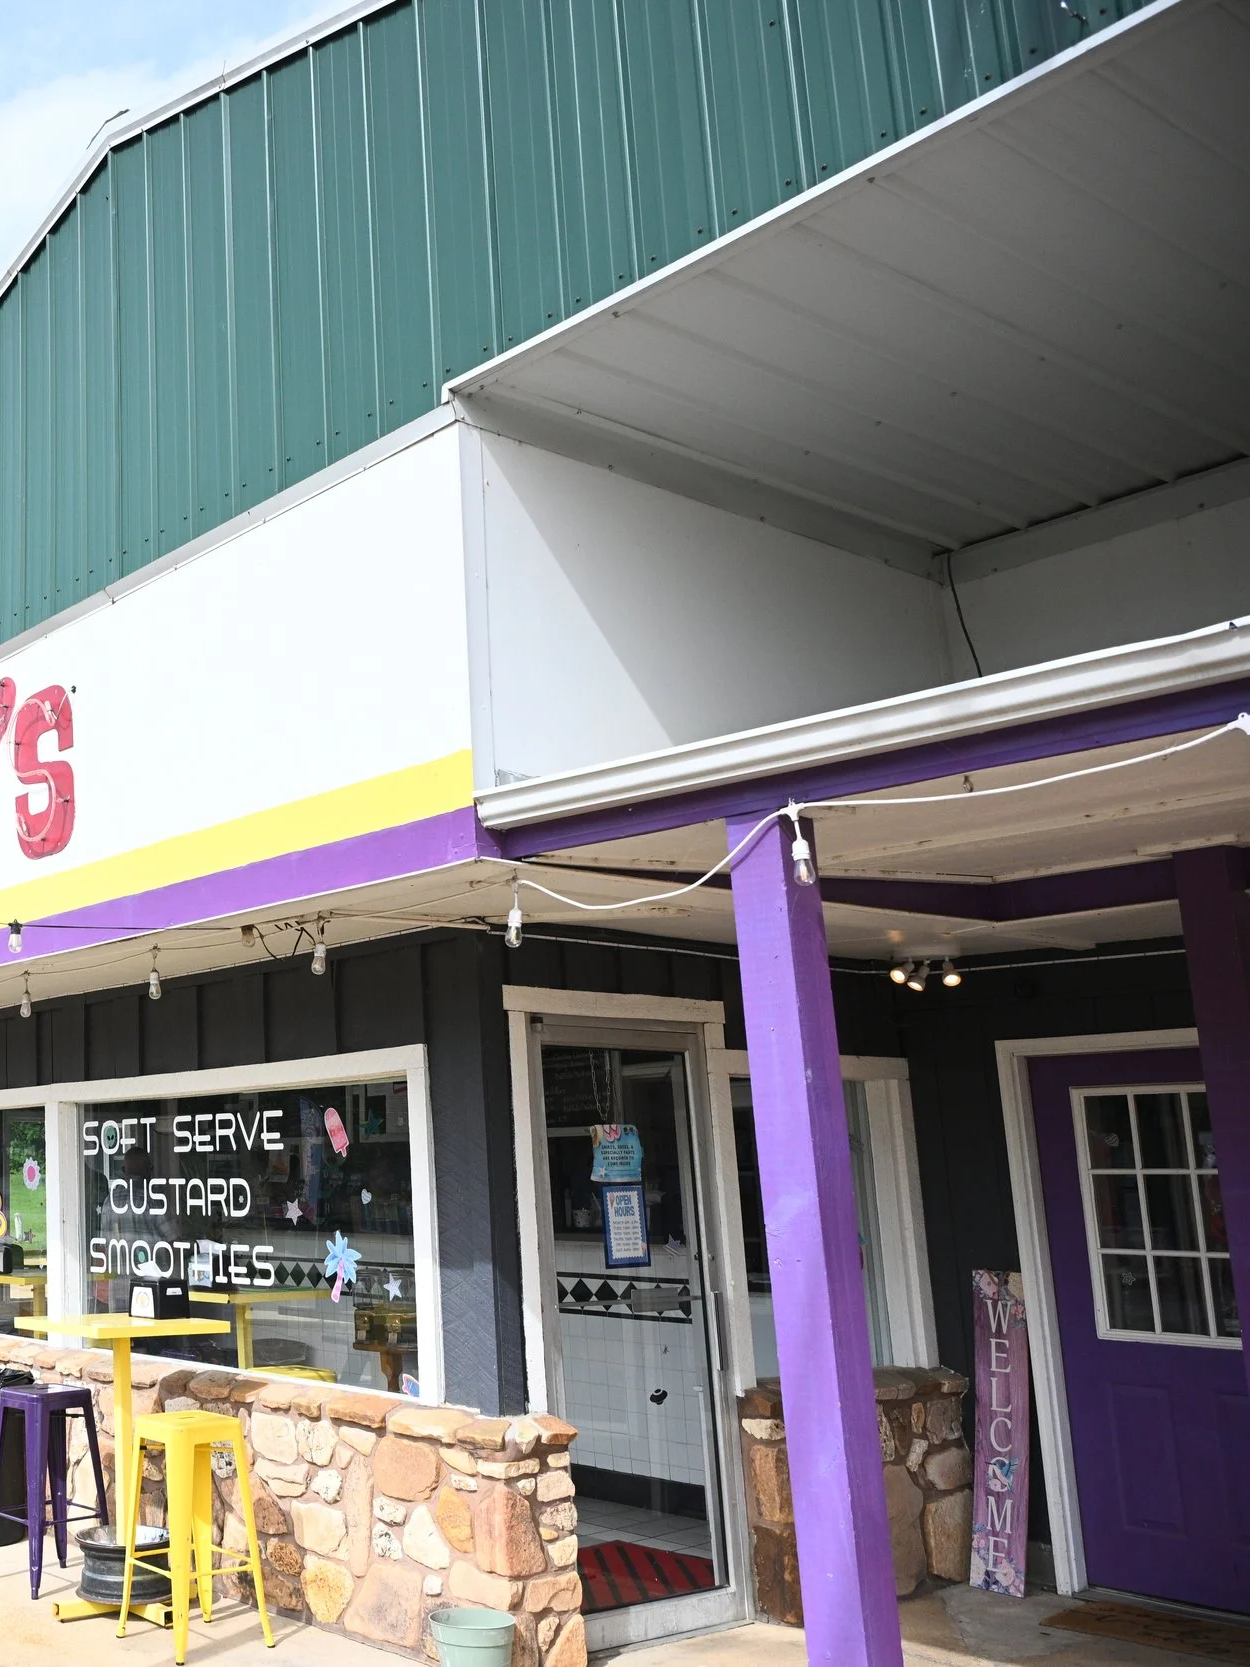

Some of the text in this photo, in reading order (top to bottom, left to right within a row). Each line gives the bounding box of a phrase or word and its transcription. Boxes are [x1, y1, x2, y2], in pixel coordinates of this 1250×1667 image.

[82, 1117, 157, 1156] SOFT
[172, 1109, 285, 1153] SERVE
[110, 1177, 251, 1218] CUSTARD
[614, 1205, 635, 1217] HOURS
[615, 1194, 632, 1206] OPEN
[89, 1238, 275, 1287] SMOOTHIES
[986, 1300, 1015, 1574] WELCOME
